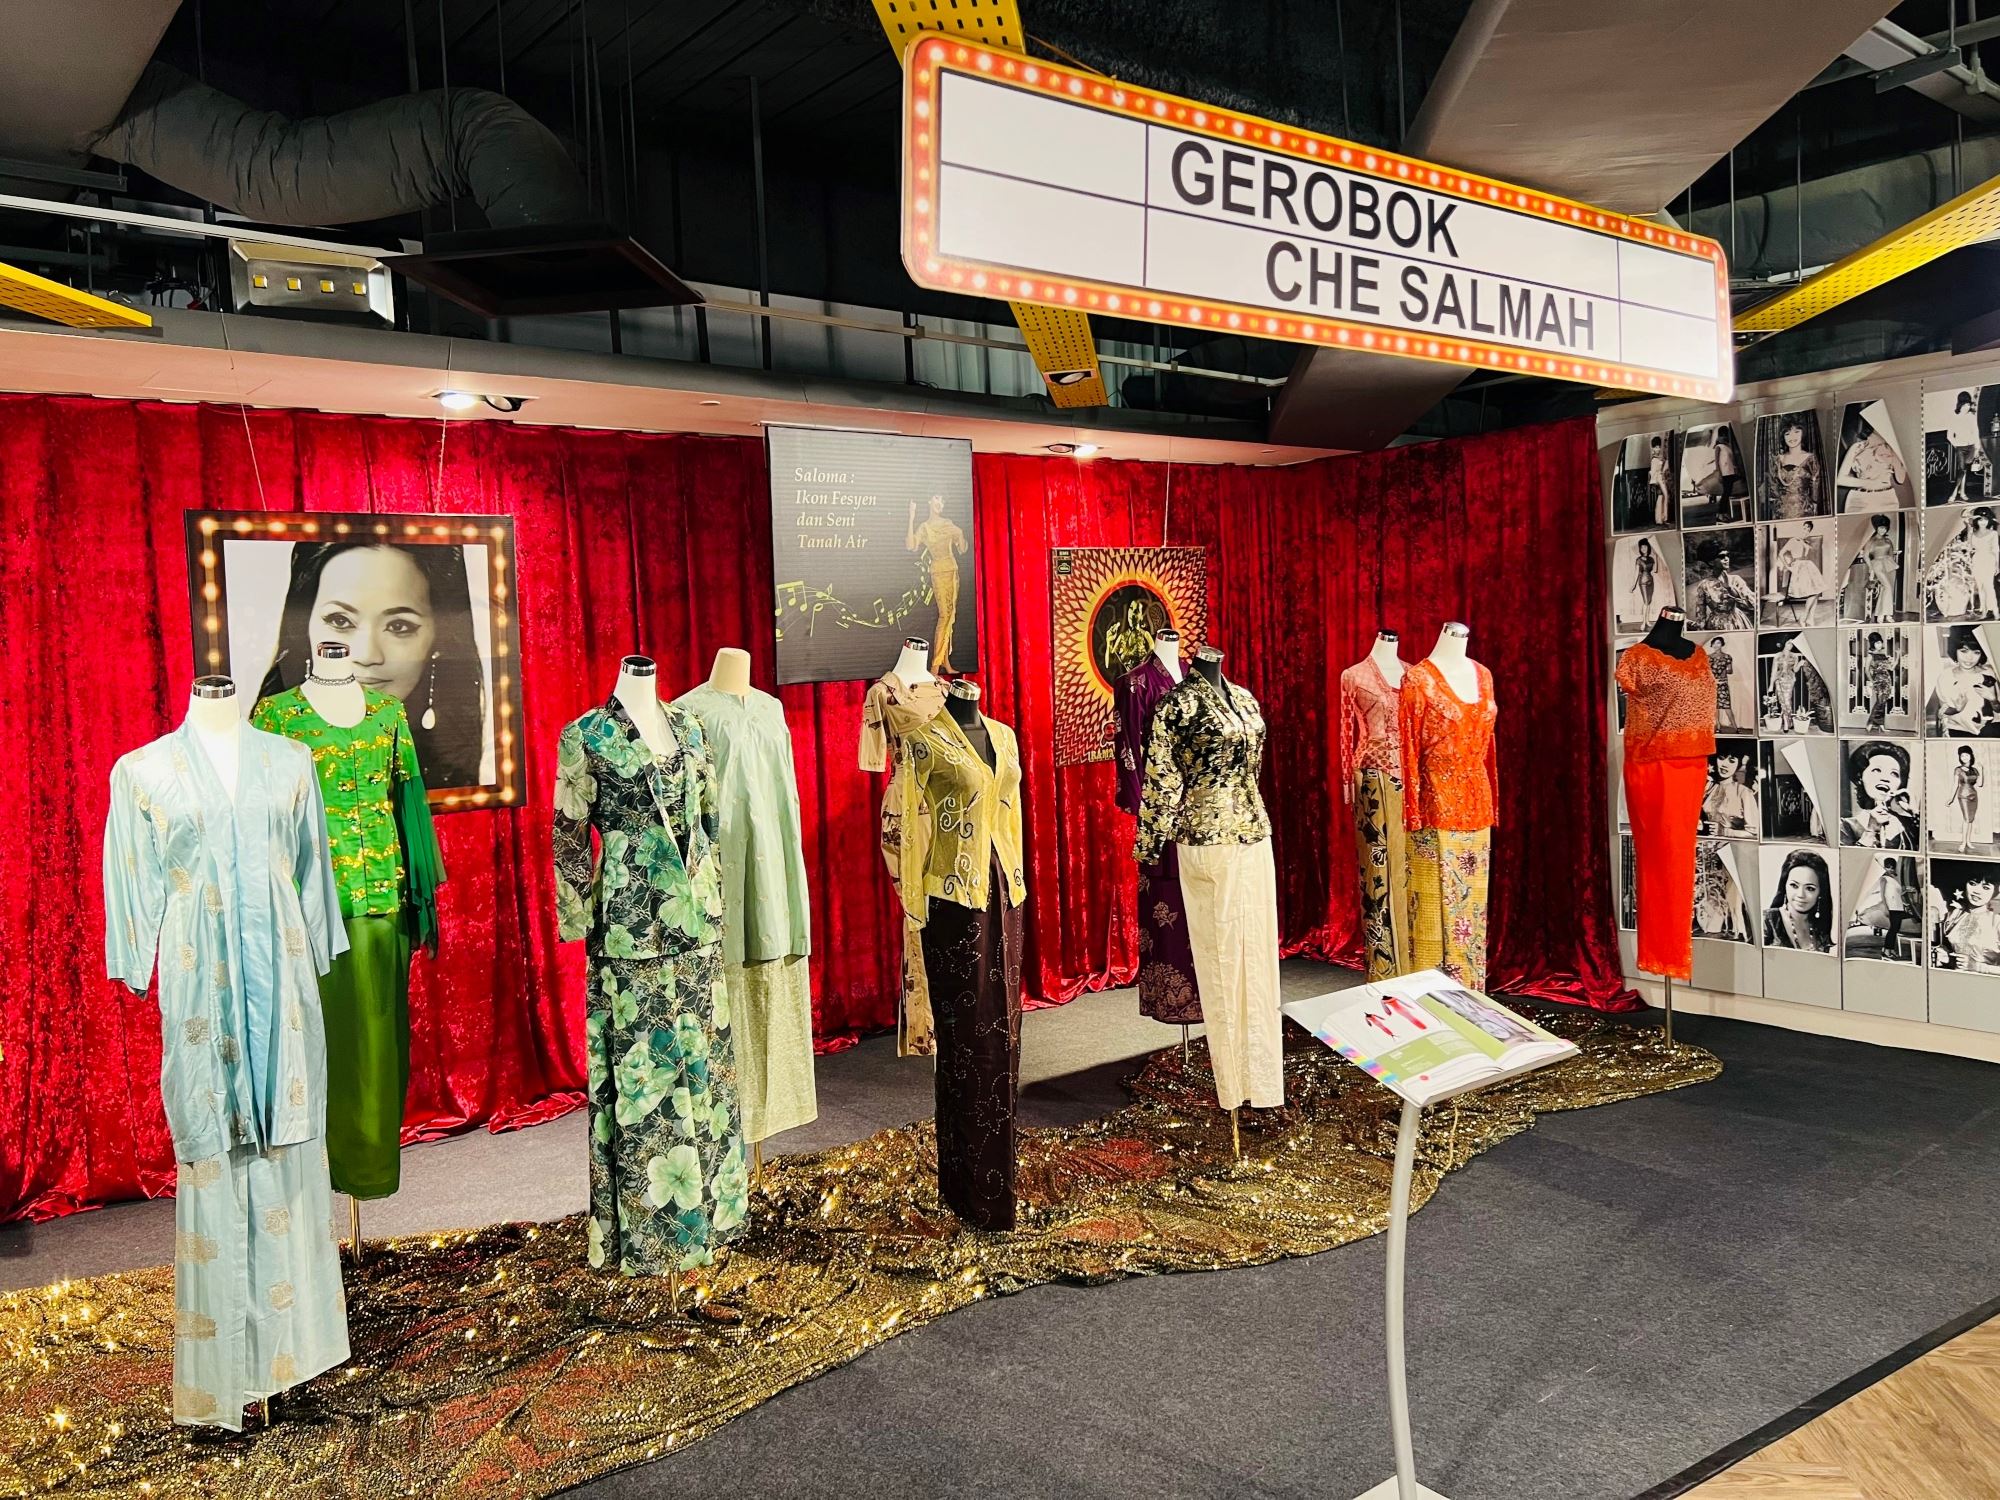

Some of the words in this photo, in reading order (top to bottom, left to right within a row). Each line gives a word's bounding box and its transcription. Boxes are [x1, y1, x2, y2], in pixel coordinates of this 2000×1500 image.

[1170, 139, 1459, 258] GEROBOK
[1265, 240, 1380, 316] CHE
[1399, 264, 1595, 352] SALMAH
[794, 467, 847, 483] Saloma
[795, 489, 828, 505] Ikon
[831, 491, 877, 511] Fesyen
[796, 512, 823, 527] dan
[826, 512, 856, 527] Seni
[797, 534, 842, 549] Tanah
[845, 534, 869, 549] Air
